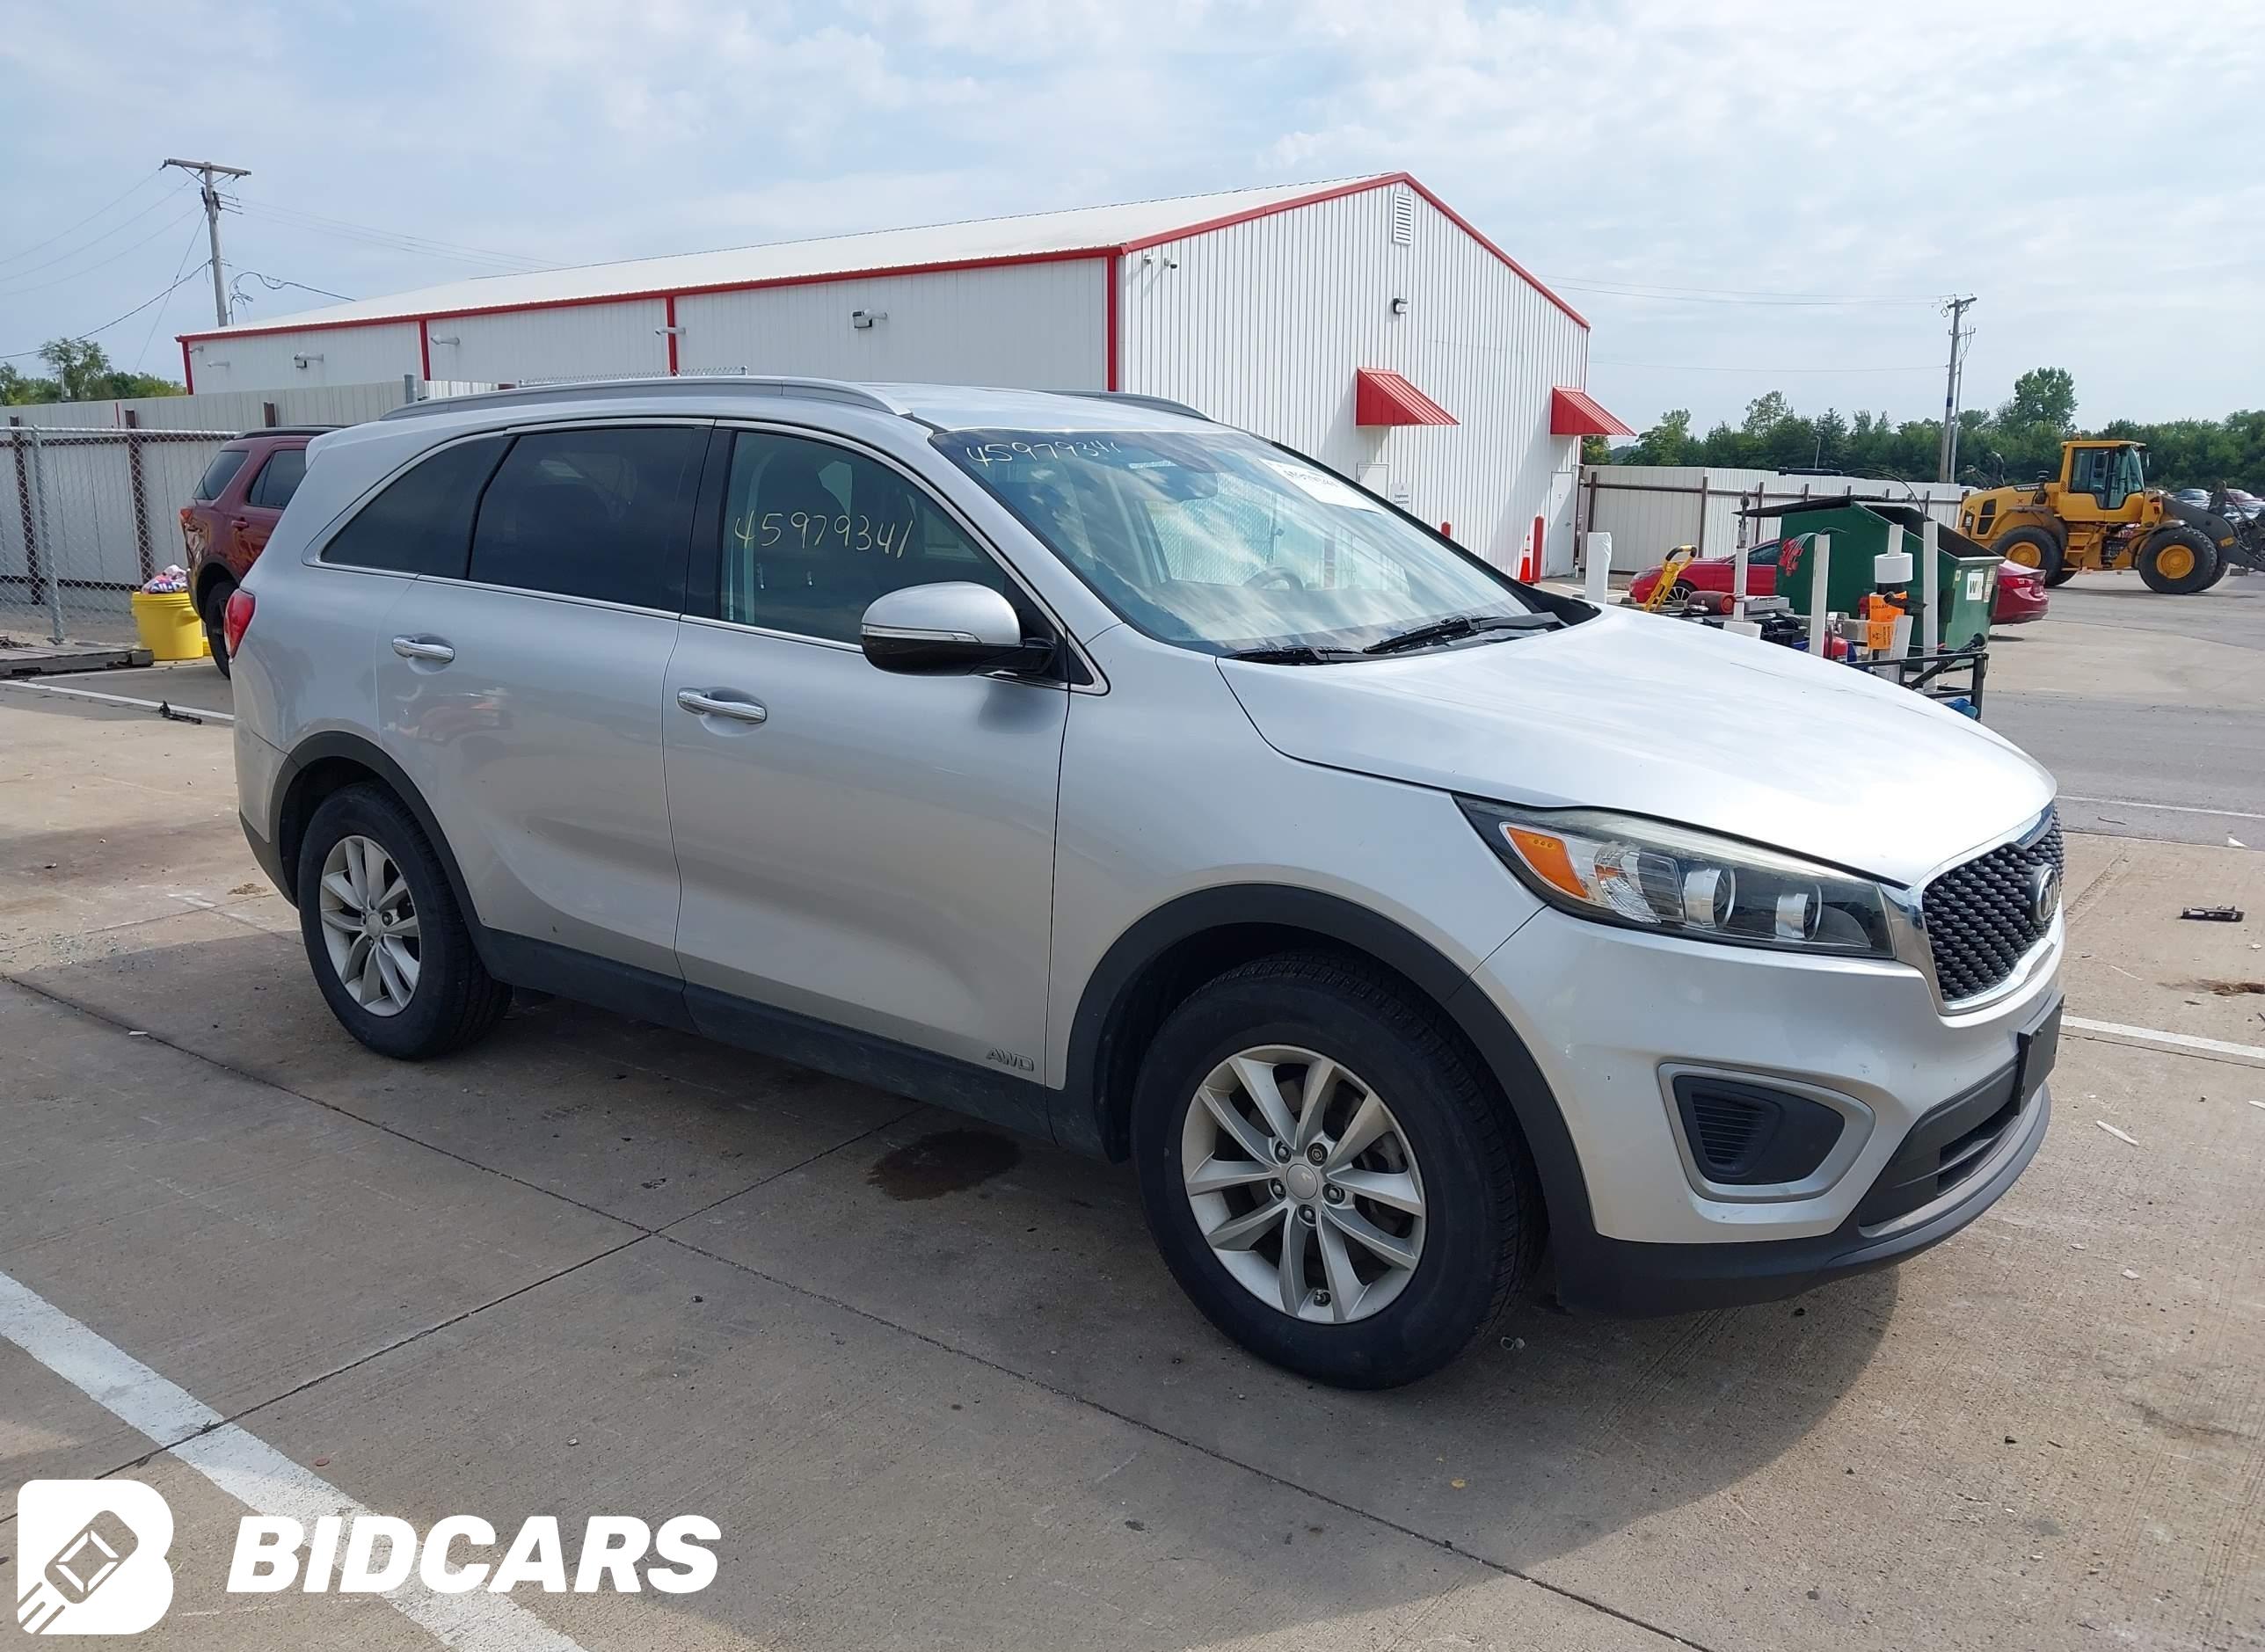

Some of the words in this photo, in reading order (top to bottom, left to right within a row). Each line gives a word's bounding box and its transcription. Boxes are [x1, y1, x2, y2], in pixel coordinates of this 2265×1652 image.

[965, 440, 1123, 468] 45979341
[734, 509, 914, 558] 45979341
[986, 1047, 1035, 1073] AWD
